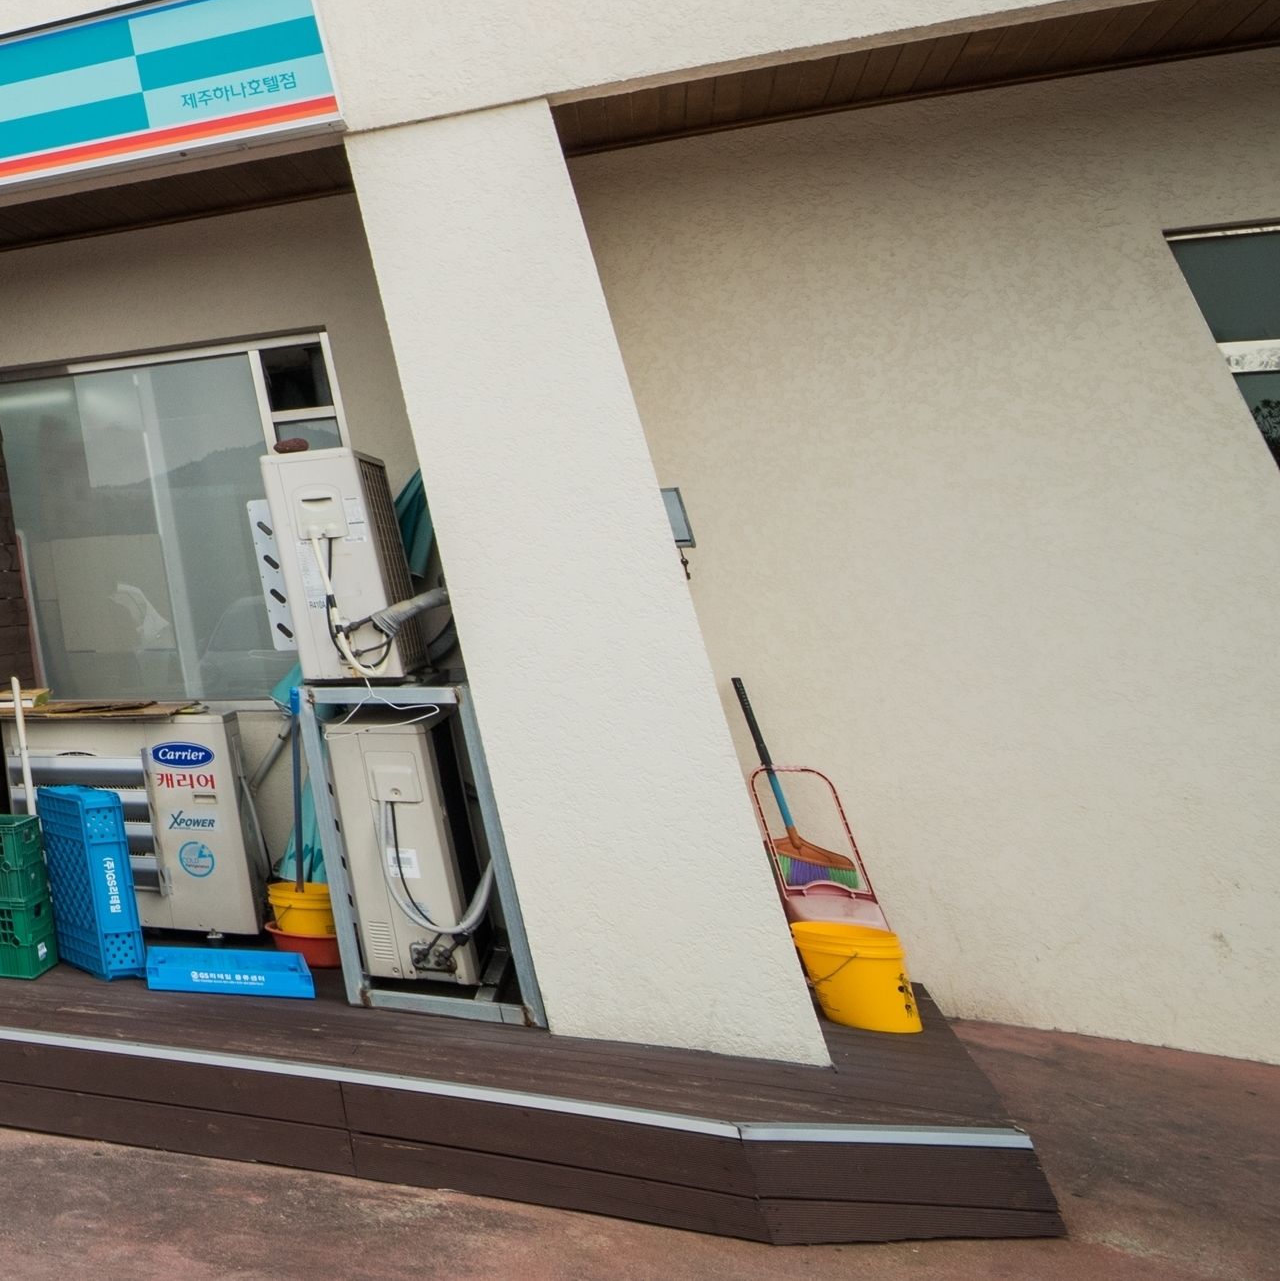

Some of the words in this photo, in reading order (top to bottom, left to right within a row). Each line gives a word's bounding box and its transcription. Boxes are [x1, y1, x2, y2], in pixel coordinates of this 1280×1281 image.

[181, 72, 297, 109] 제주하나호텔점
[158, 748, 206, 761] Carrier
[156, 772, 216, 789] 캐리어
